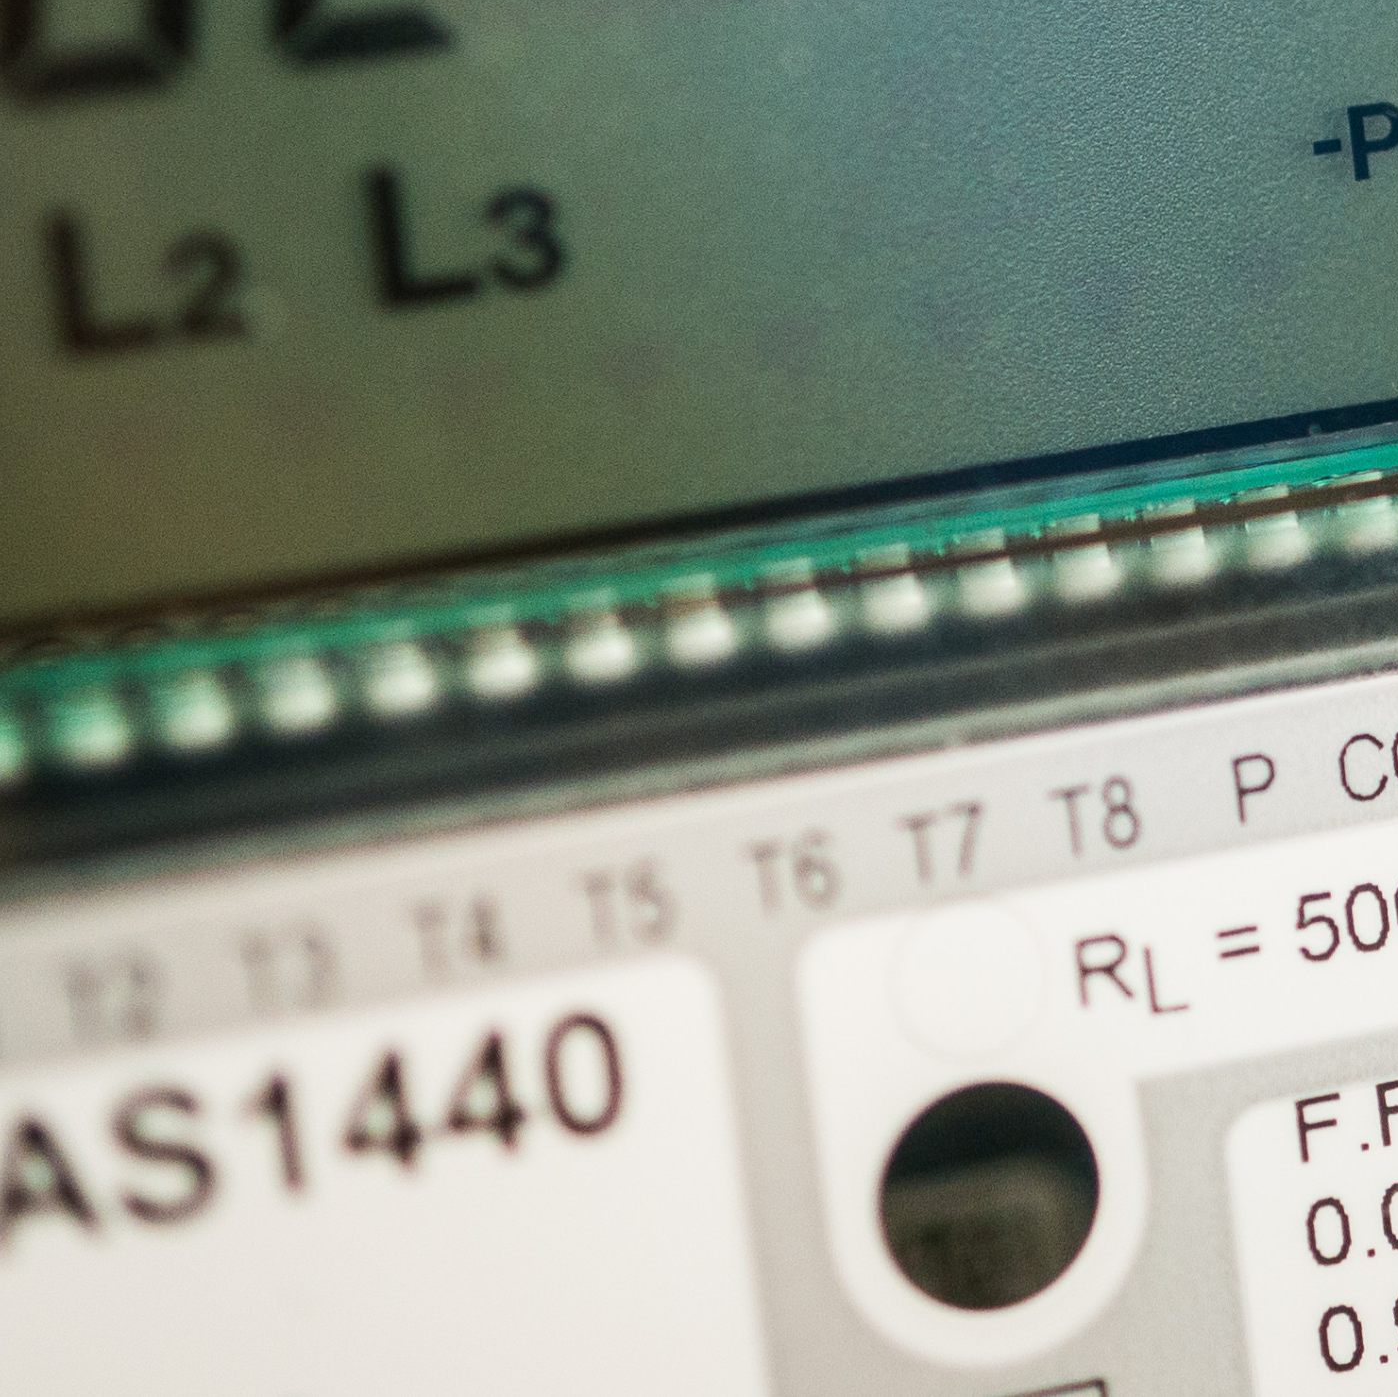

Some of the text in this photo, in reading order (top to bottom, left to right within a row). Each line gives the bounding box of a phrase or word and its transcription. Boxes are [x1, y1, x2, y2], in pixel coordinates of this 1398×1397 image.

[45, 210, 248, 357] L2
[363, 164, 568, 310] L3
[745, 830, 842, 916] T6
[899, 801, 985, 884] T7
[1049, 775, 1142, 858] T8
[1231, 753, 1276, 824] P
[0, 1010, 626, 1254] AS1440
